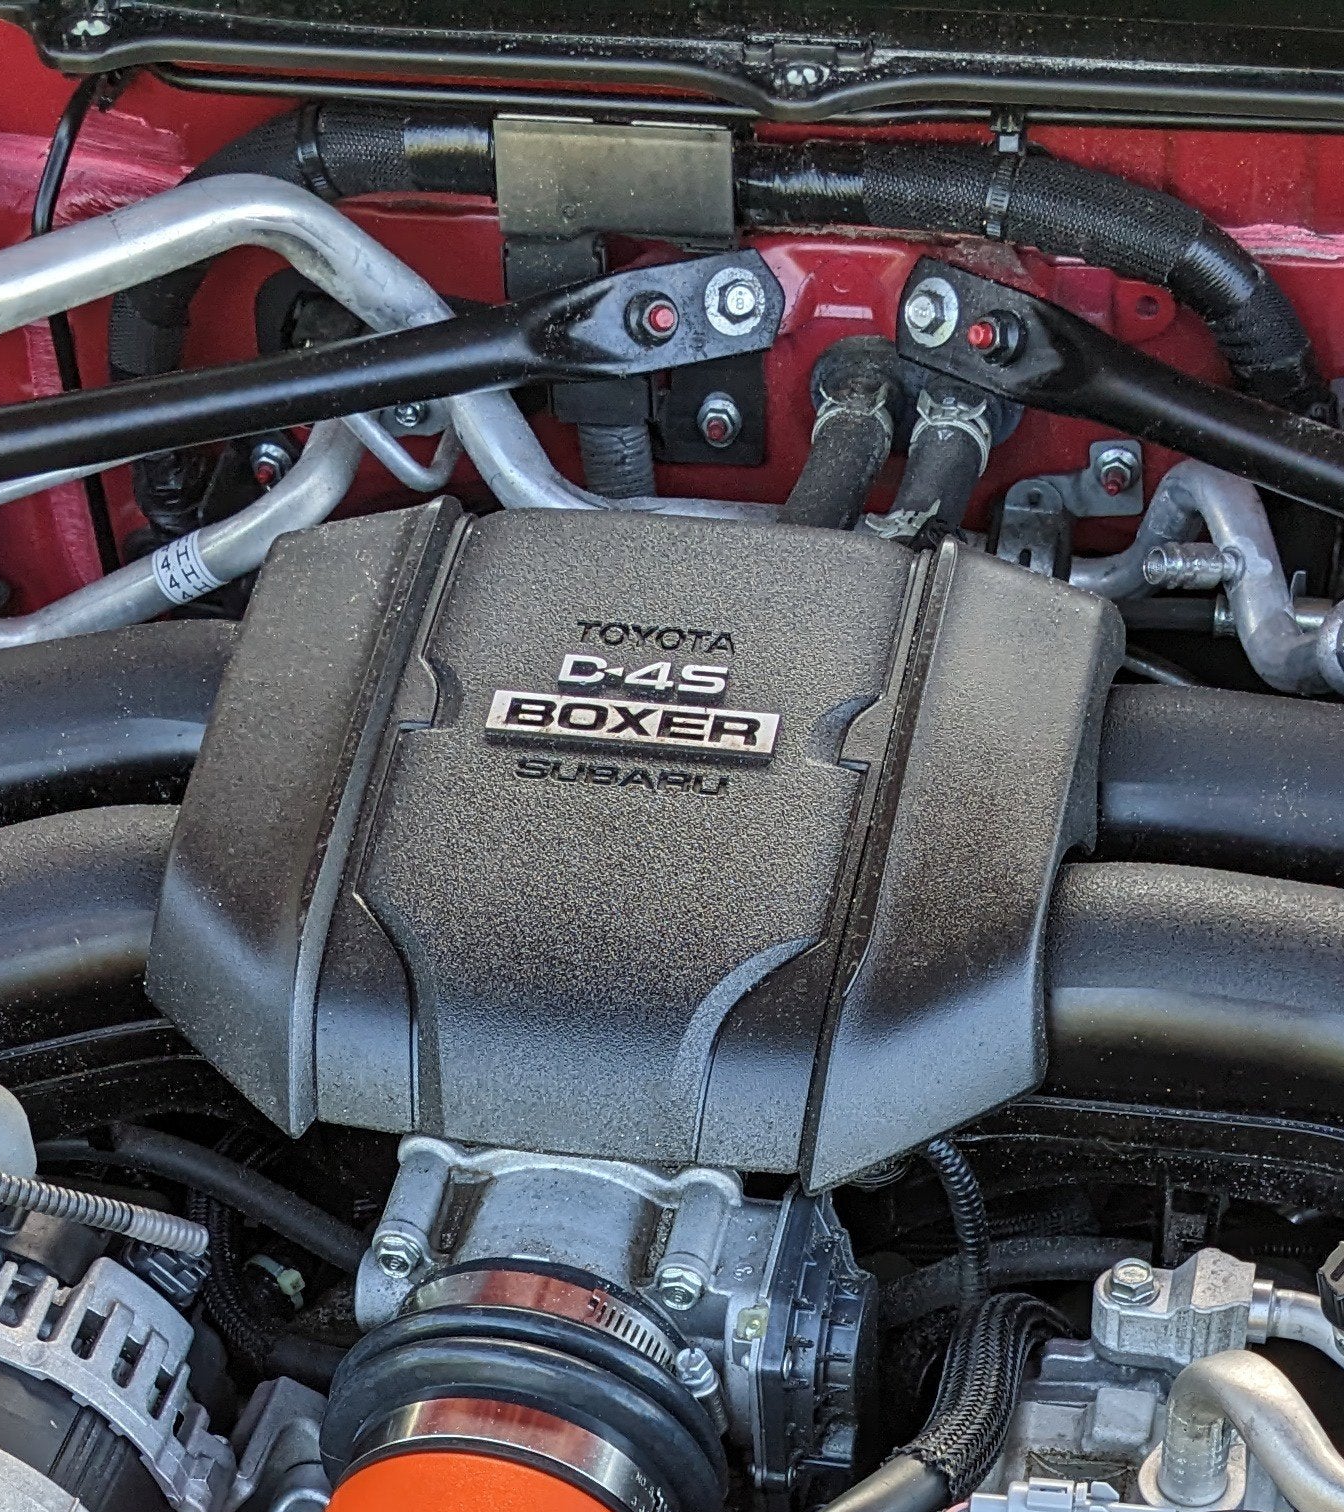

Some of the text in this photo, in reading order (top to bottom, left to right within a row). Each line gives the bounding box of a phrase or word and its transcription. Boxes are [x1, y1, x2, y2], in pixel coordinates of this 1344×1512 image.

[576, 620, 736, 654] TOYOTA
[506, 698, 761, 745] BOXER
[513, 757, 730, 796] SUBARU
